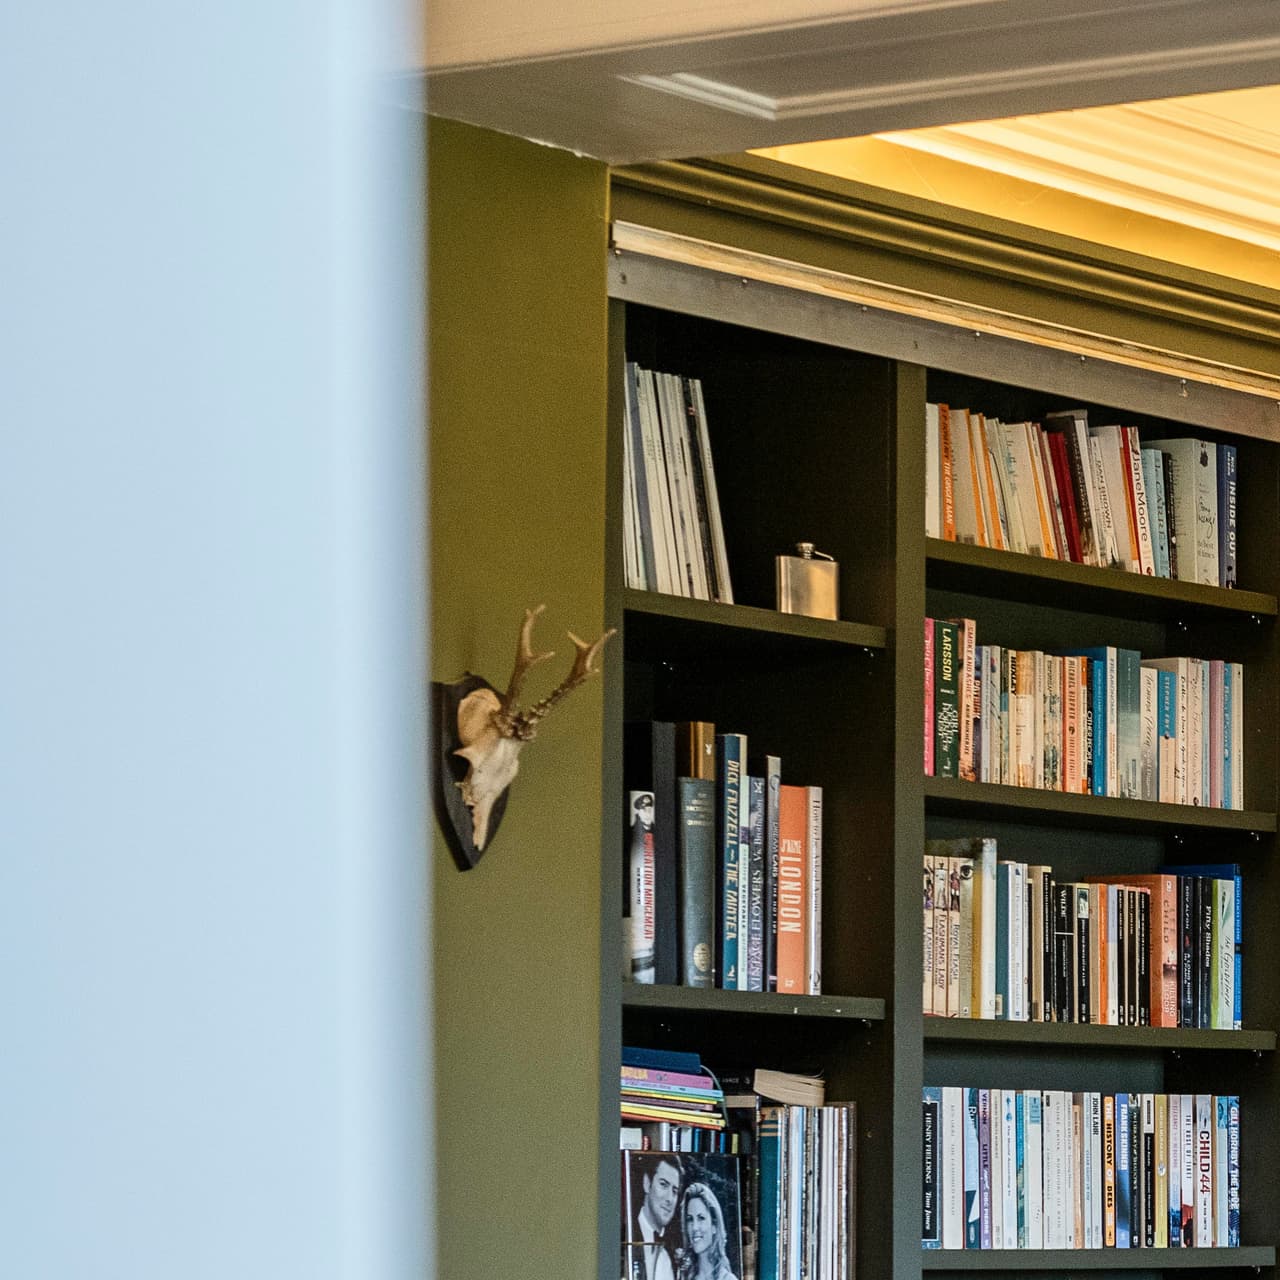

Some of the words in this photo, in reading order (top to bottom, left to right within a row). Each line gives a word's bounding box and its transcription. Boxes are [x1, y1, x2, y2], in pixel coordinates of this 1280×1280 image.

[942, 628, 952, 682] LARSSON
[727, 760, 738, 785] DICK
[727, 789, 737, 848] FRIZZELL
[752, 870, 762, 930] FLOWERS
[780, 856, 801, 934] LONDON
[750, 937, 762, 991] VINTAGE
[938, 967, 946, 990] LADY
[1120, 1104, 1128, 1132] FRANK
[1230, 1107, 1238, 1125] GILL
[925, 1143, 933, 1184] FIELDING
[1200, 1131, 1210, 1172] CHILD
[1230, 1127, 1238, 1167] HORNBY
[1200, 1175, 1210, 1195] 44
